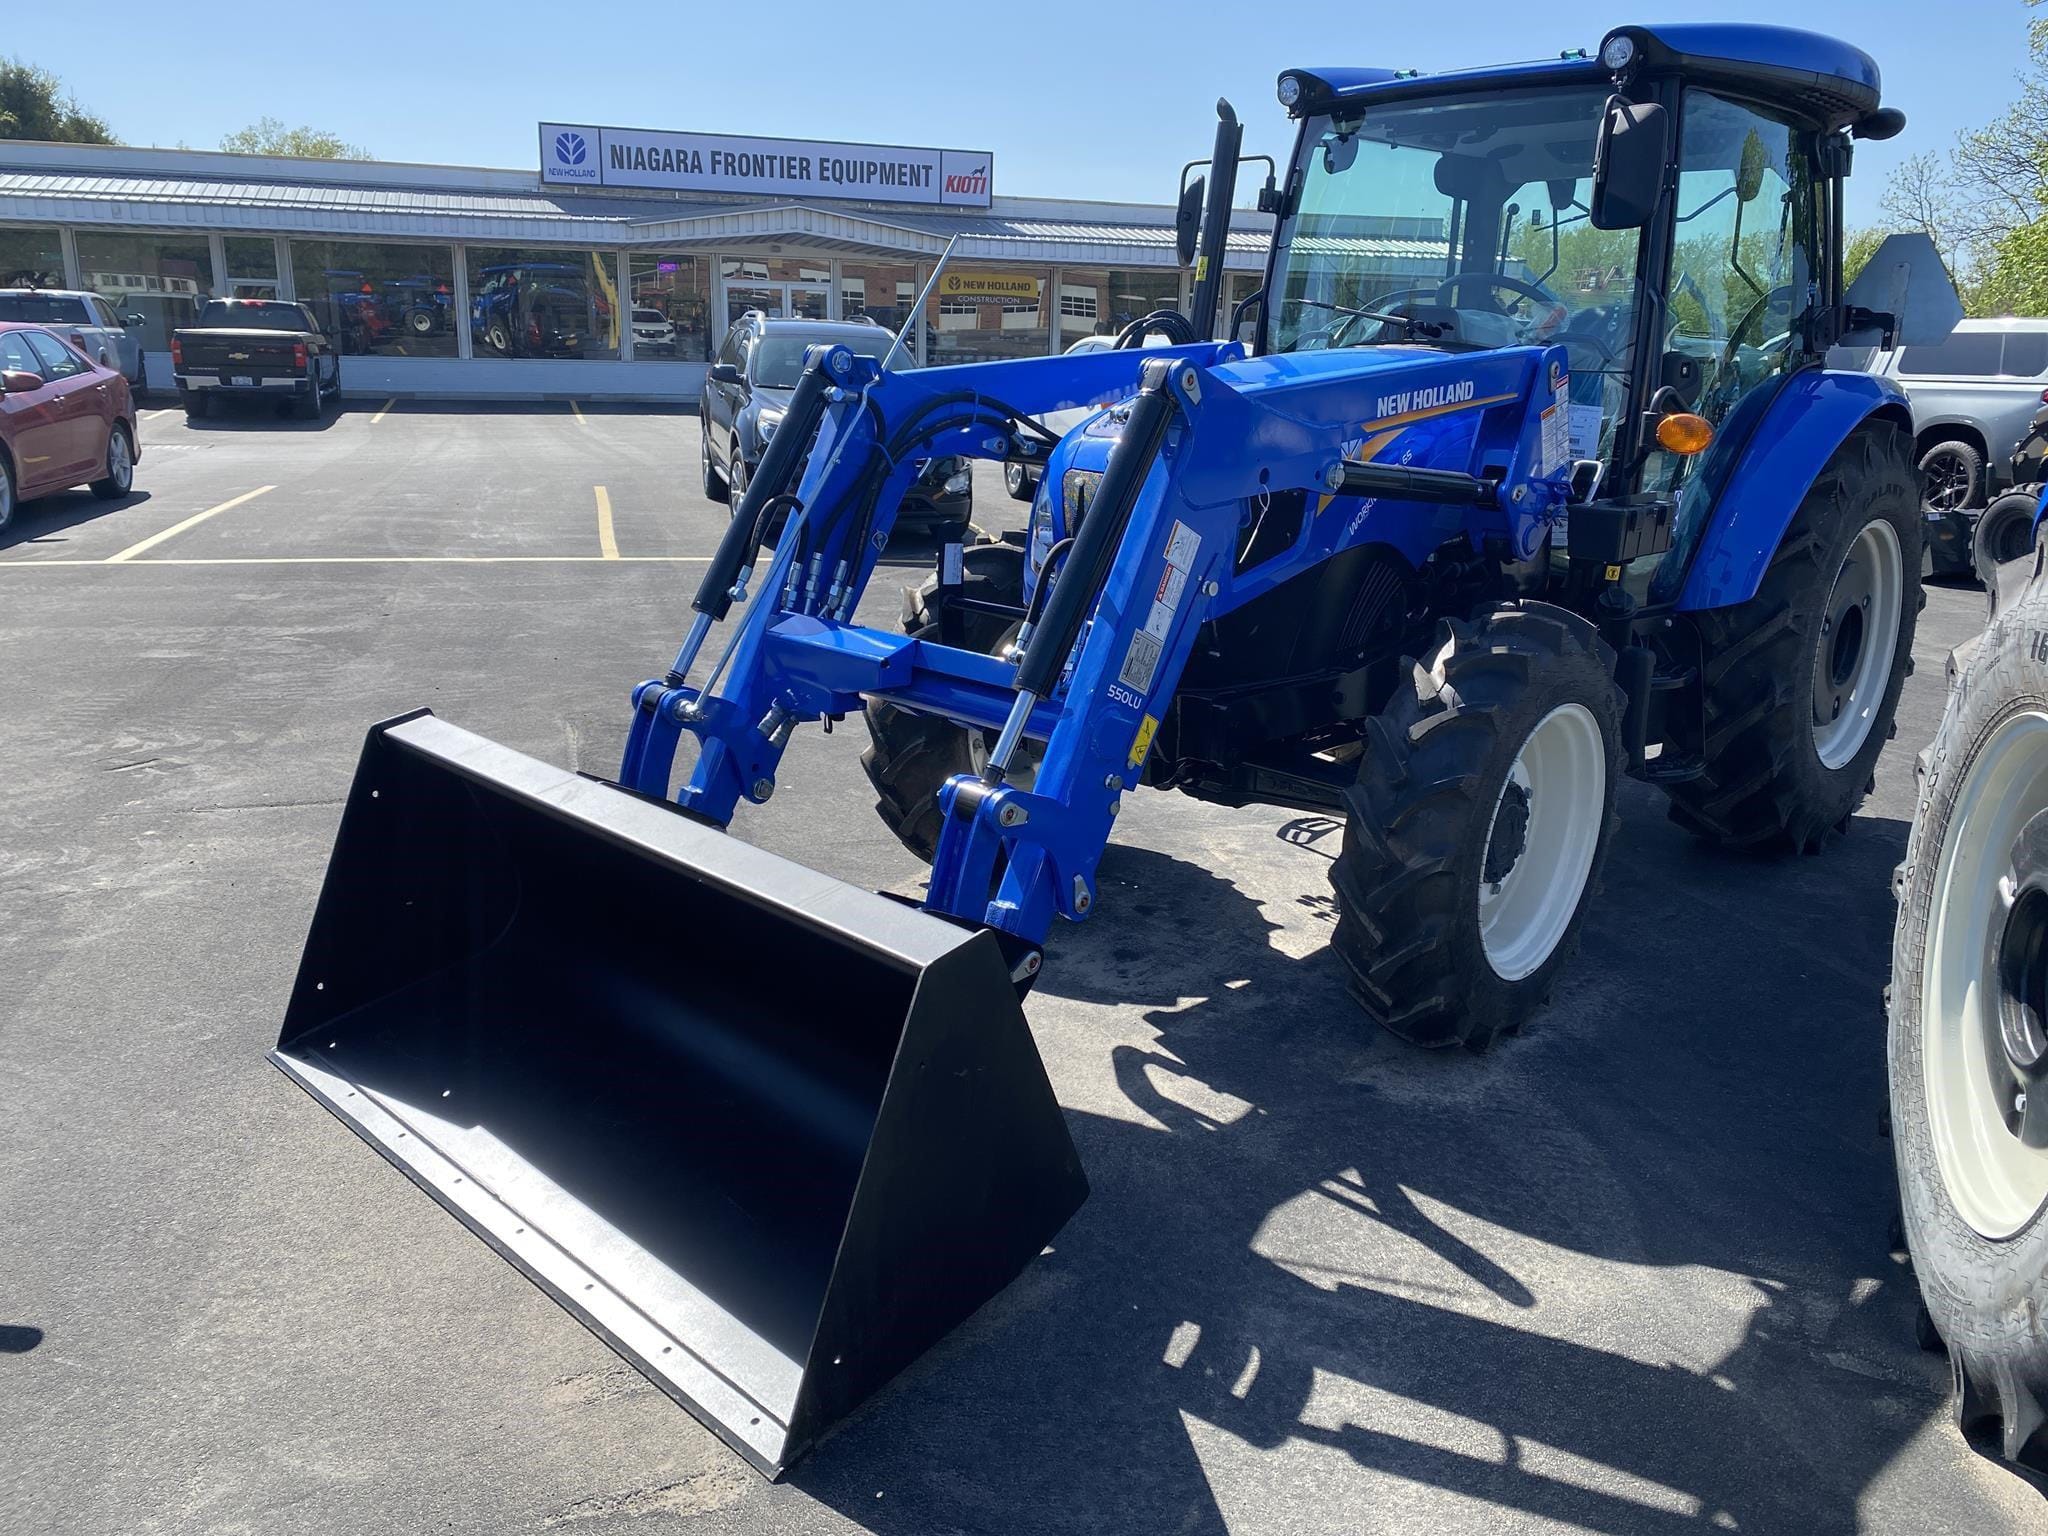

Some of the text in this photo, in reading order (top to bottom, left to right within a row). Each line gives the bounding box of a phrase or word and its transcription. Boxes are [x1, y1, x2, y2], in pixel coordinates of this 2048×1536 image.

[548, 167, 596, 178] NEW HOLLAND
[610, 144, 933, 188] NIAGARA FRONTIER EQUIPMENT
[944, 175, 987, 194] KIOTI
[963, 280, 1031, 291] NEW HOLLAND
[957, 295, 1020, 304] CONSTRUCTION
[1377, 380, 1474, 418] NEW HOLLAND
[1349, 497, 1378, 536] WORK
[1159, 565, 1173, 593] DANGER
[1107, 684, 1142, 710] 550LU
